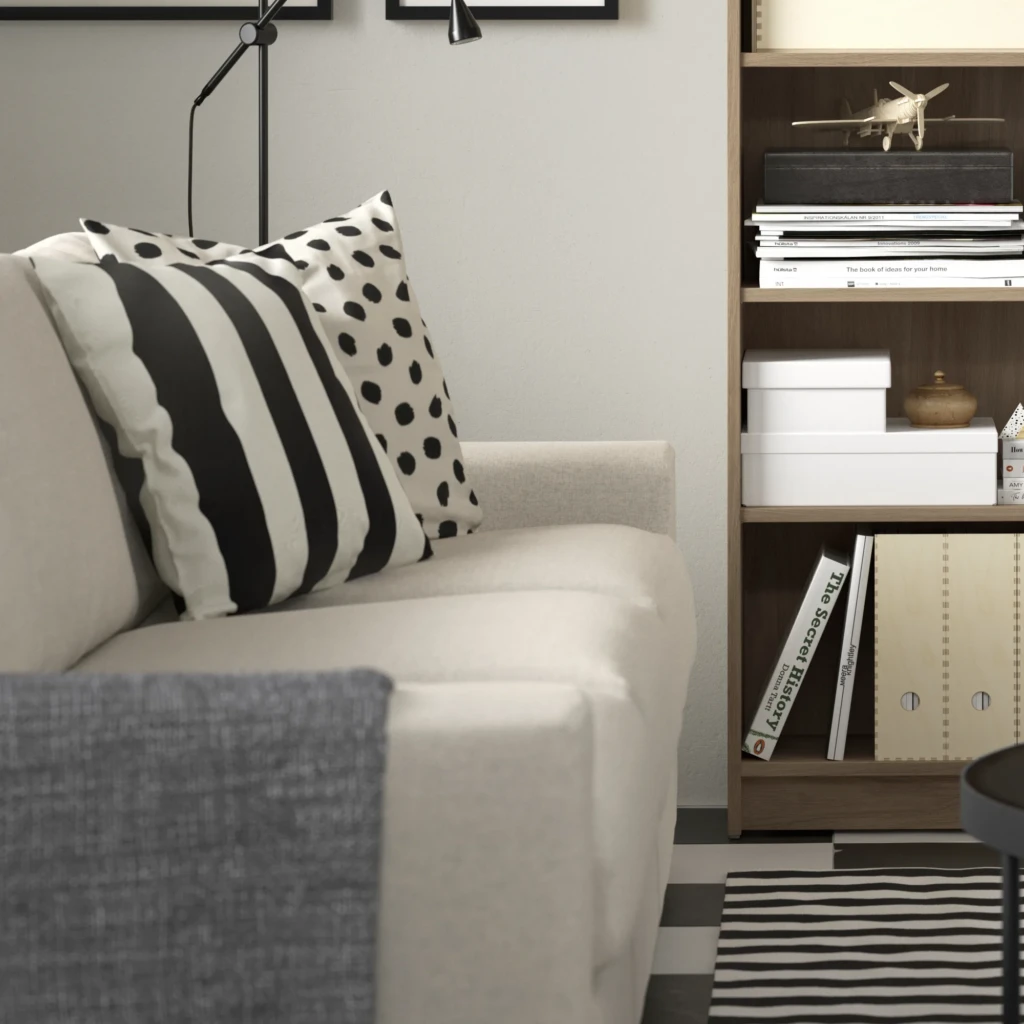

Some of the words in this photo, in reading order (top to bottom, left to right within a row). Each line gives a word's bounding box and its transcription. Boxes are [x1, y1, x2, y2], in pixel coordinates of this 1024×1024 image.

[821, 572, 844, 605] The
[797, 608, 828, 663] Secret
[775, 663, 790, 690] Donna
[765, 692, 778, 712] Tartt
[766, 665, 804, 732] History
